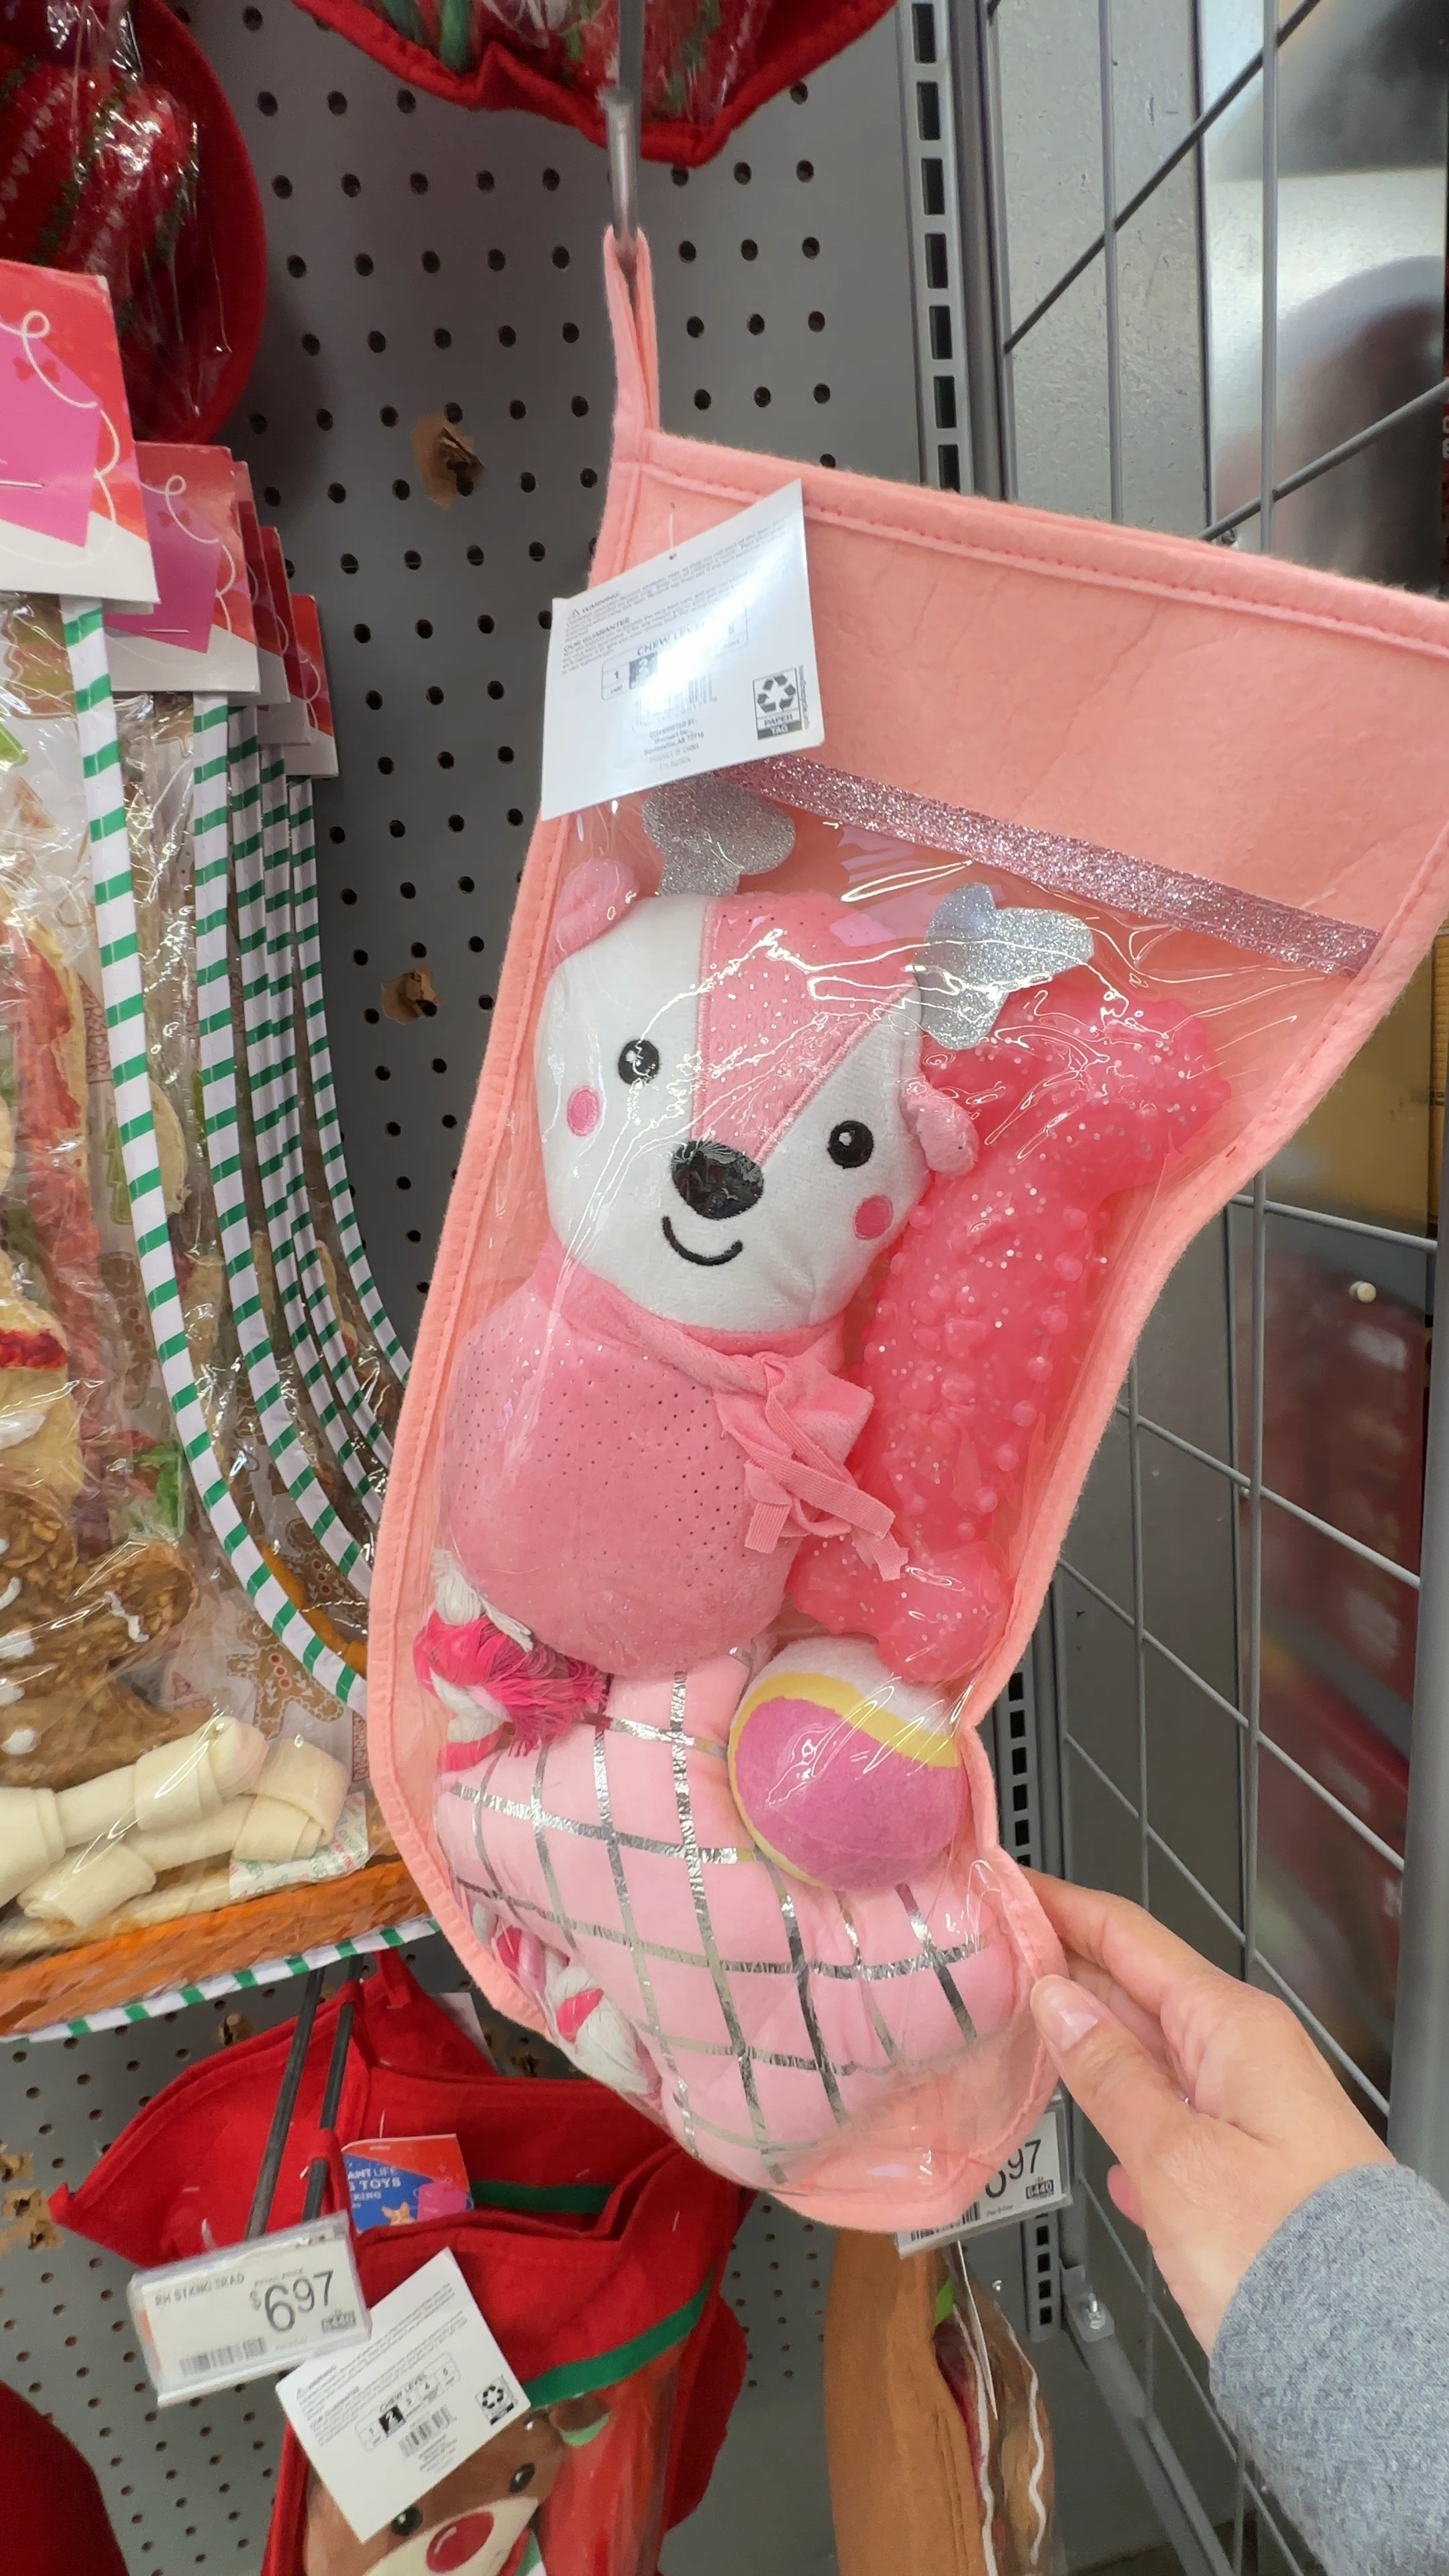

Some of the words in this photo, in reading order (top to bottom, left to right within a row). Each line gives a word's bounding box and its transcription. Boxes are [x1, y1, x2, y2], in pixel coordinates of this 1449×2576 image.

[764, 714, 793, 726] PAPER
[771, 724, 788, 736] TAG
[359, 2176, 402, 2190] TOYS
[354, 2190, 382, 2201] KING
